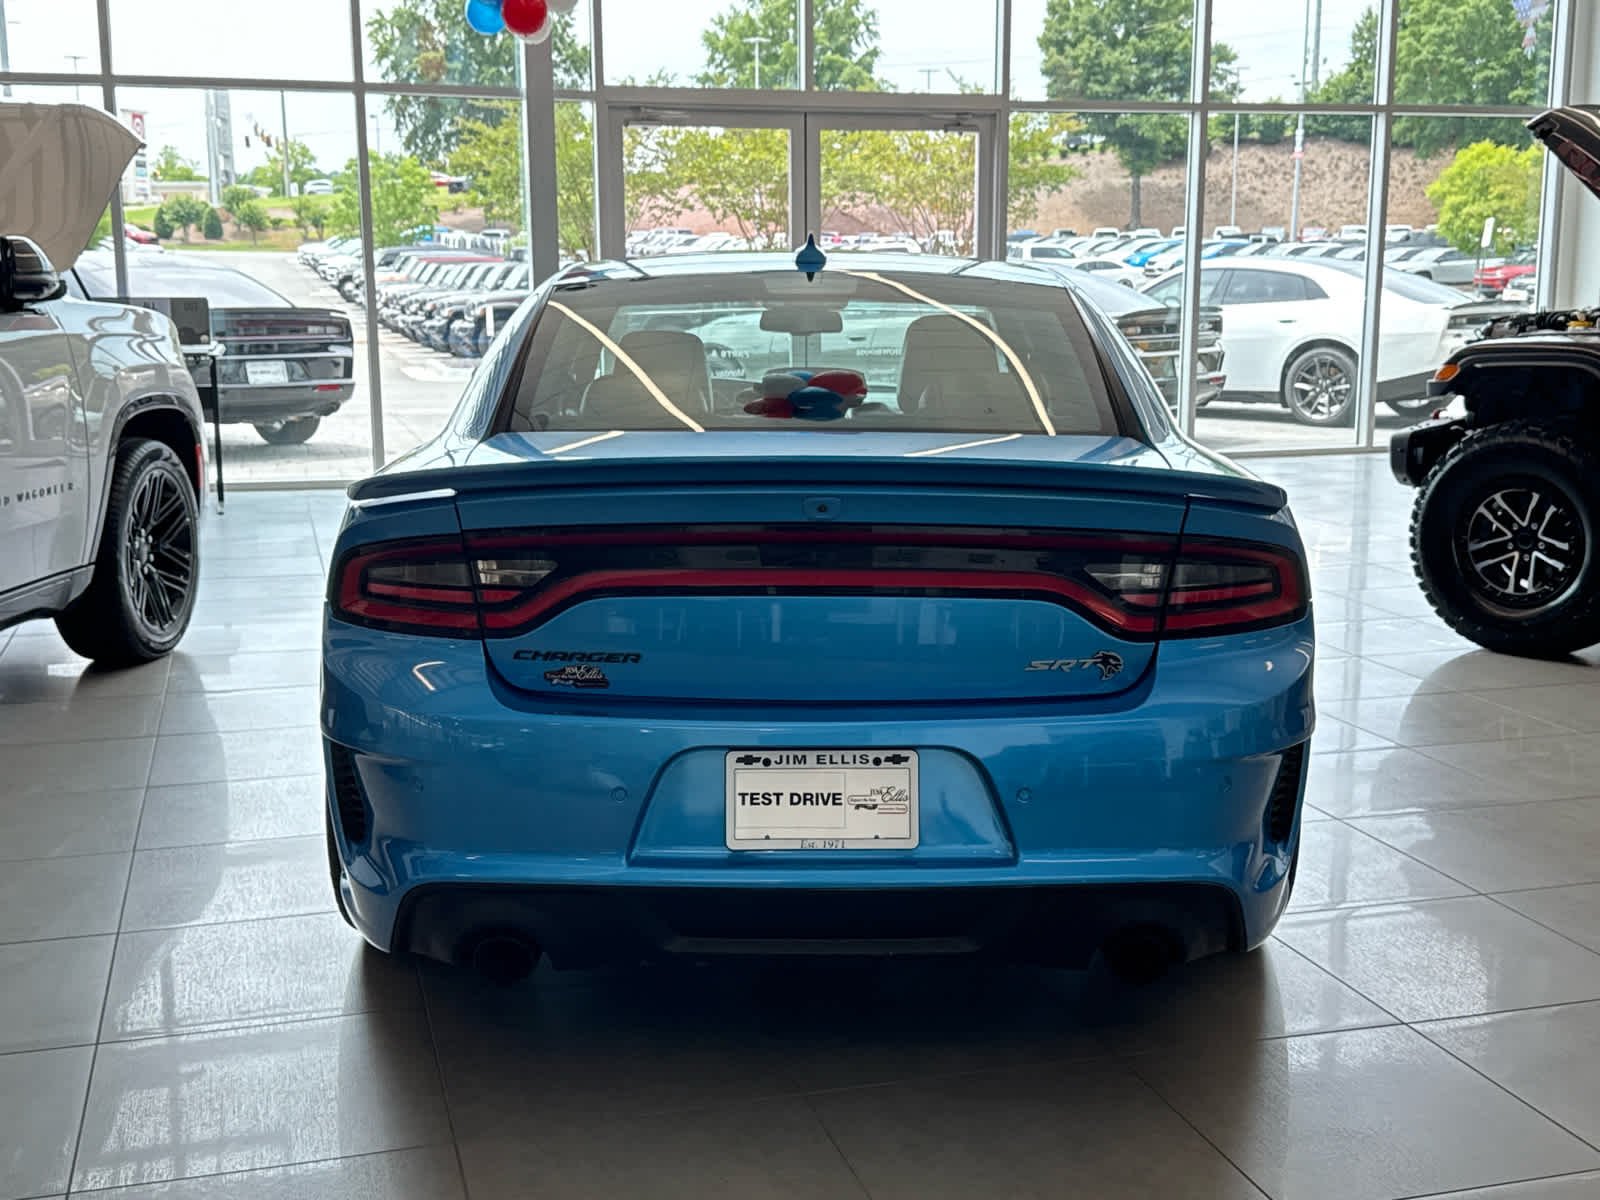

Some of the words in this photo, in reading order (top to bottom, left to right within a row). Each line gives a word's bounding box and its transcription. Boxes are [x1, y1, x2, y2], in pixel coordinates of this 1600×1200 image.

[512, 649, 642, 663] CHARGER
[576, 664, 603, 680] Ellis
[1024, 658, 1102, 672] SRT
[774, 754, 807, 765] JIM
[816, 754, 870, 765] ELLIS
[738, 792, 783, 806] TEST
[789, 792, 843, 806] DRIVE
[881, 786, 908, 802] Ellis
[800, 840, 817, 849] Est.
[822, 840, 846, 849] 1971
